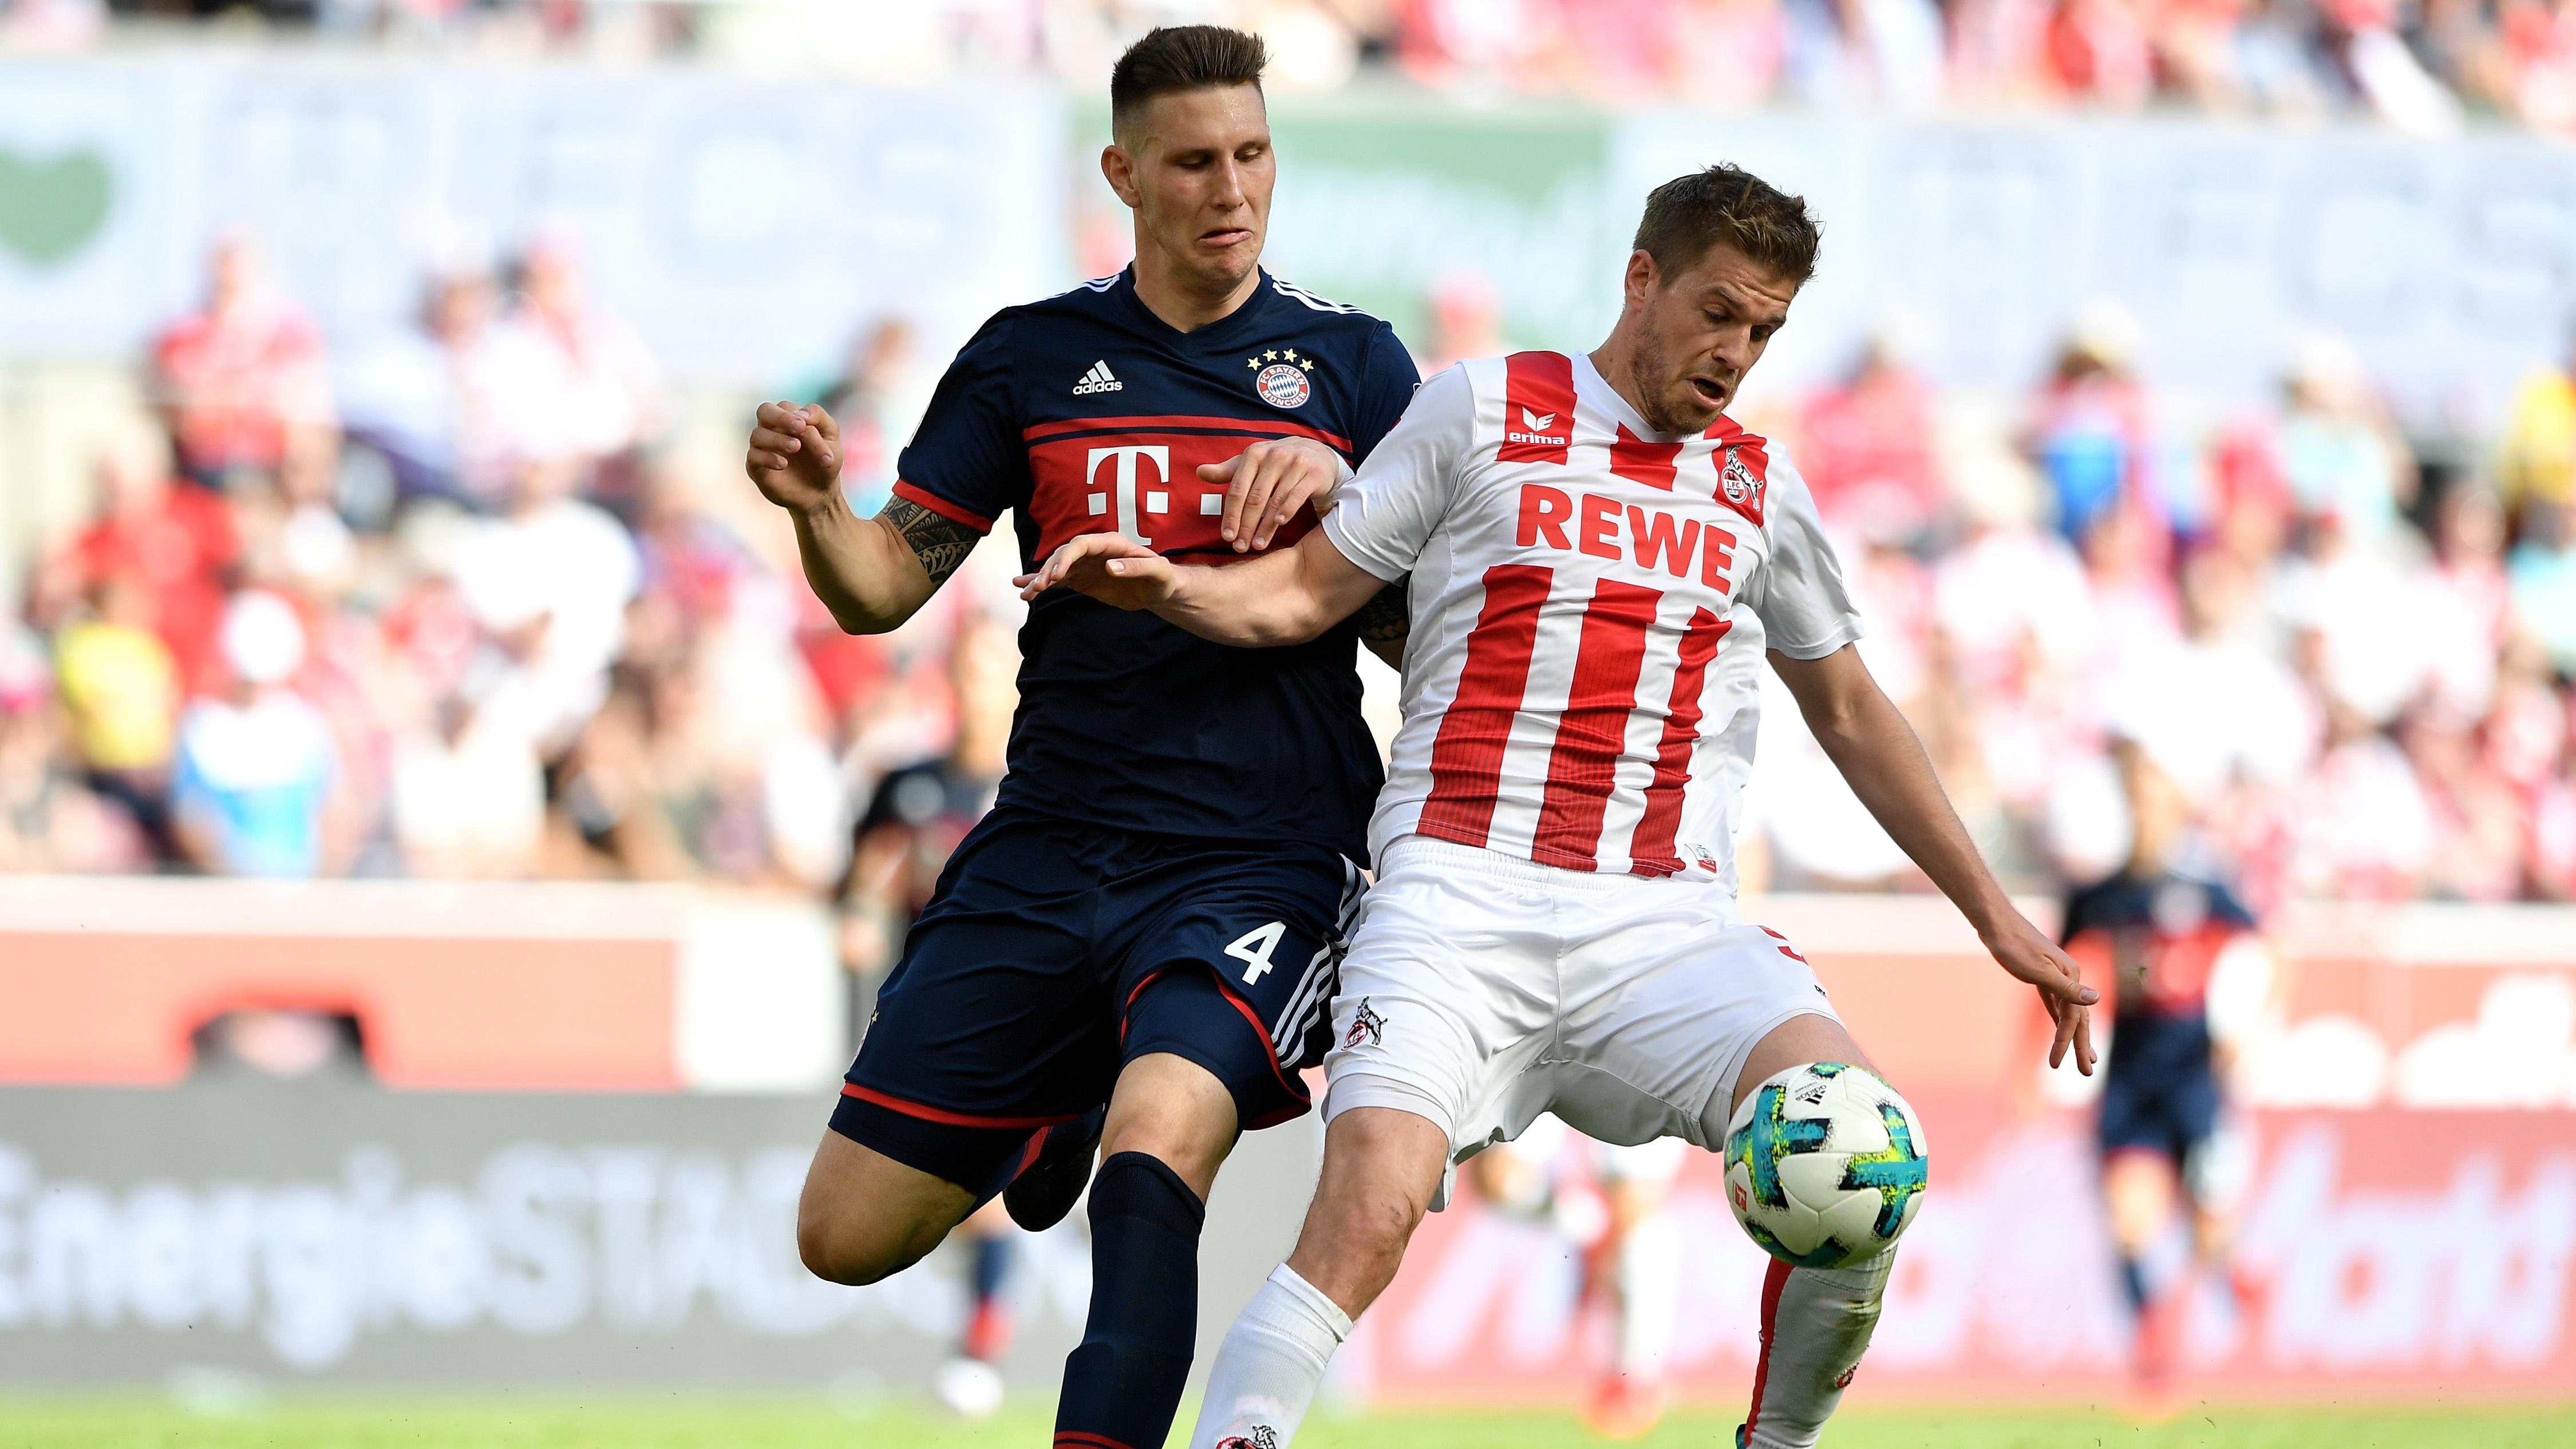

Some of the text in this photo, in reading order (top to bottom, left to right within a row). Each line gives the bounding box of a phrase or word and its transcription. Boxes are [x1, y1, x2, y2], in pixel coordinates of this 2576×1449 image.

[1260, 367, 1306, 385] FC BAYERN
[1072, 380, 1123, 395] adidas
[1508, 432, 1566, 445] erima
[1515, 483, 1737, 596] REWE
[1223, 920, 1286, 986] 4
[1795, 1085, 1827, 1101] adidas
